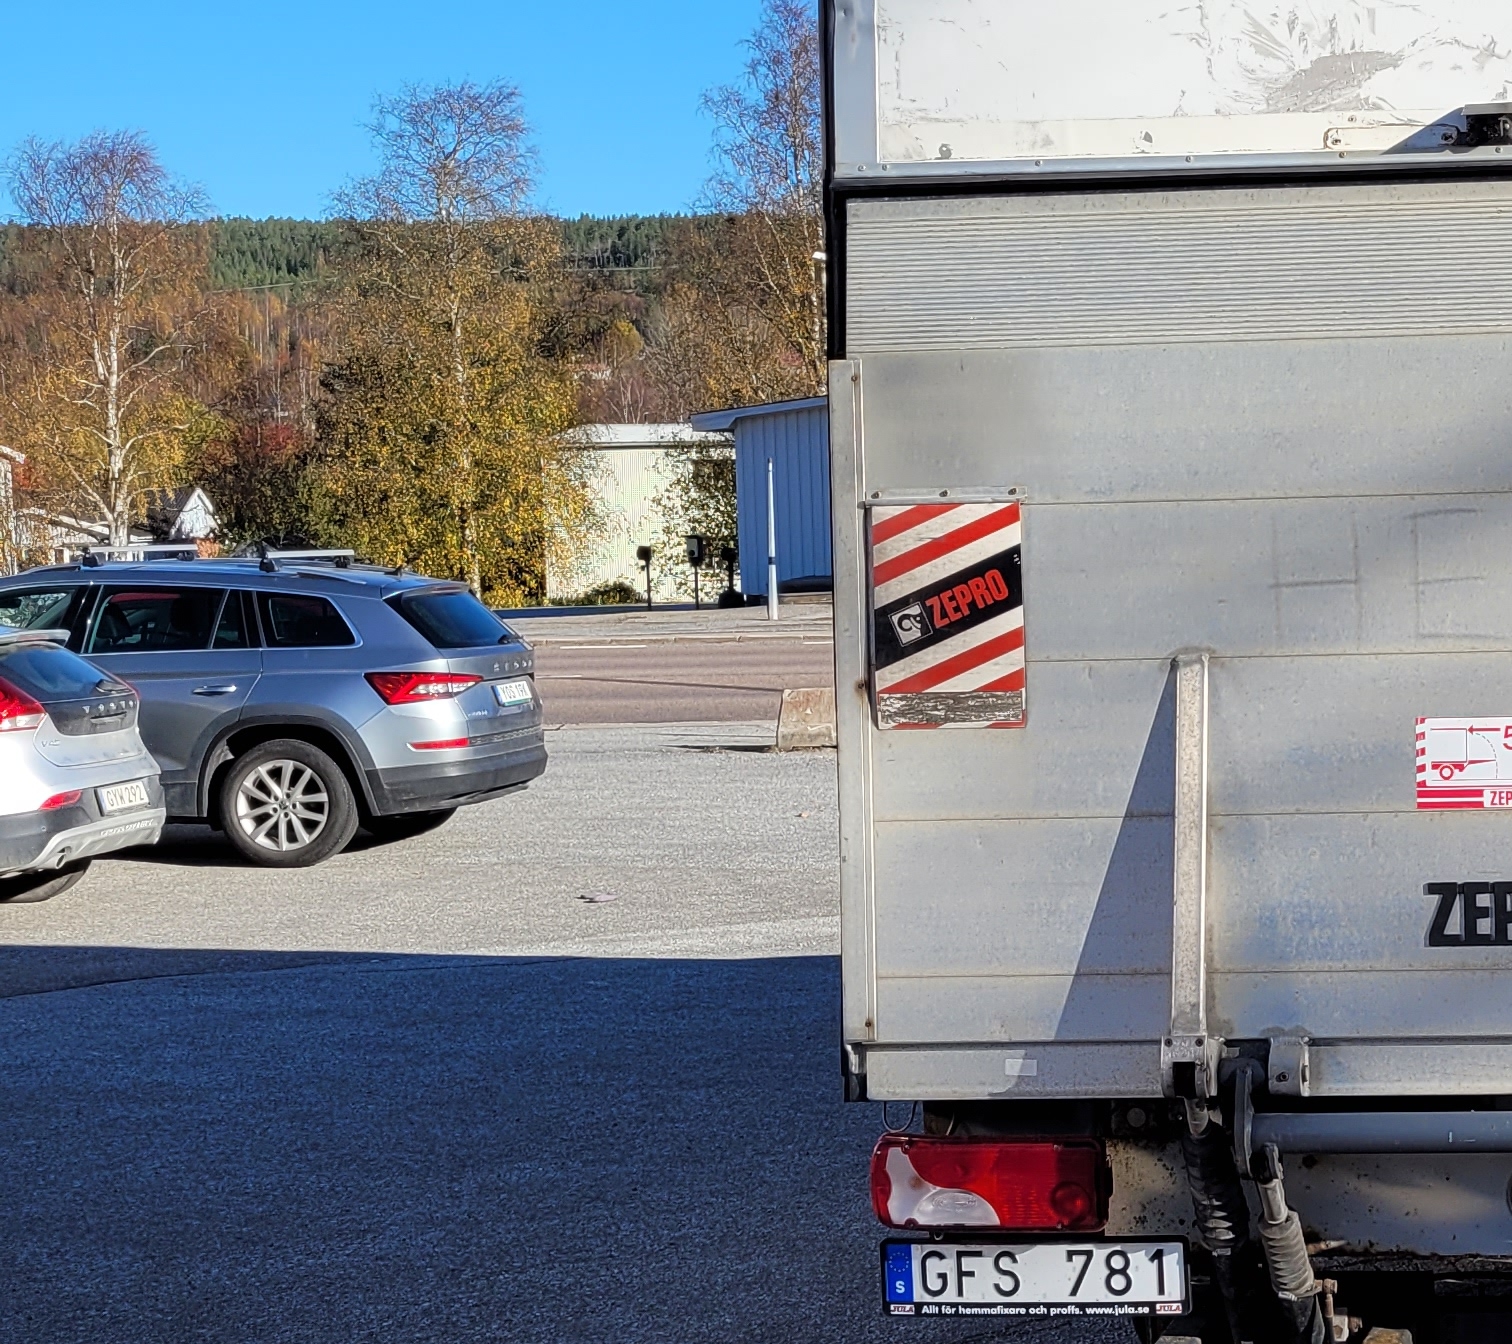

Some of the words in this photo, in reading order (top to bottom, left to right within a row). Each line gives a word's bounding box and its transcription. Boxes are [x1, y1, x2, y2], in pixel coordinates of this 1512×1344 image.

[925, 568, 1009, 629] ZEPRO
[124, 784, 145, 805] 292
[920, 1249, 1021, 1298] GFS
[1064, 1248, 1166, 1298] 781
[895, 1280, 905, 1294] S
[891, 1304, 915, 1313] JULA
[921, 1305, 939, 1314] Allt
[941, 1305, 956, 1314] för
[959, 1304, 1027, 1315] hemmafixare
[1028, 1305, 1047, 1314] och
[1050, 1305, 1083, 1316] proffs.
[1086, 1304, 1150, 1316] www.jula.se
[1157, 1304, 1182, 1313] JULA
